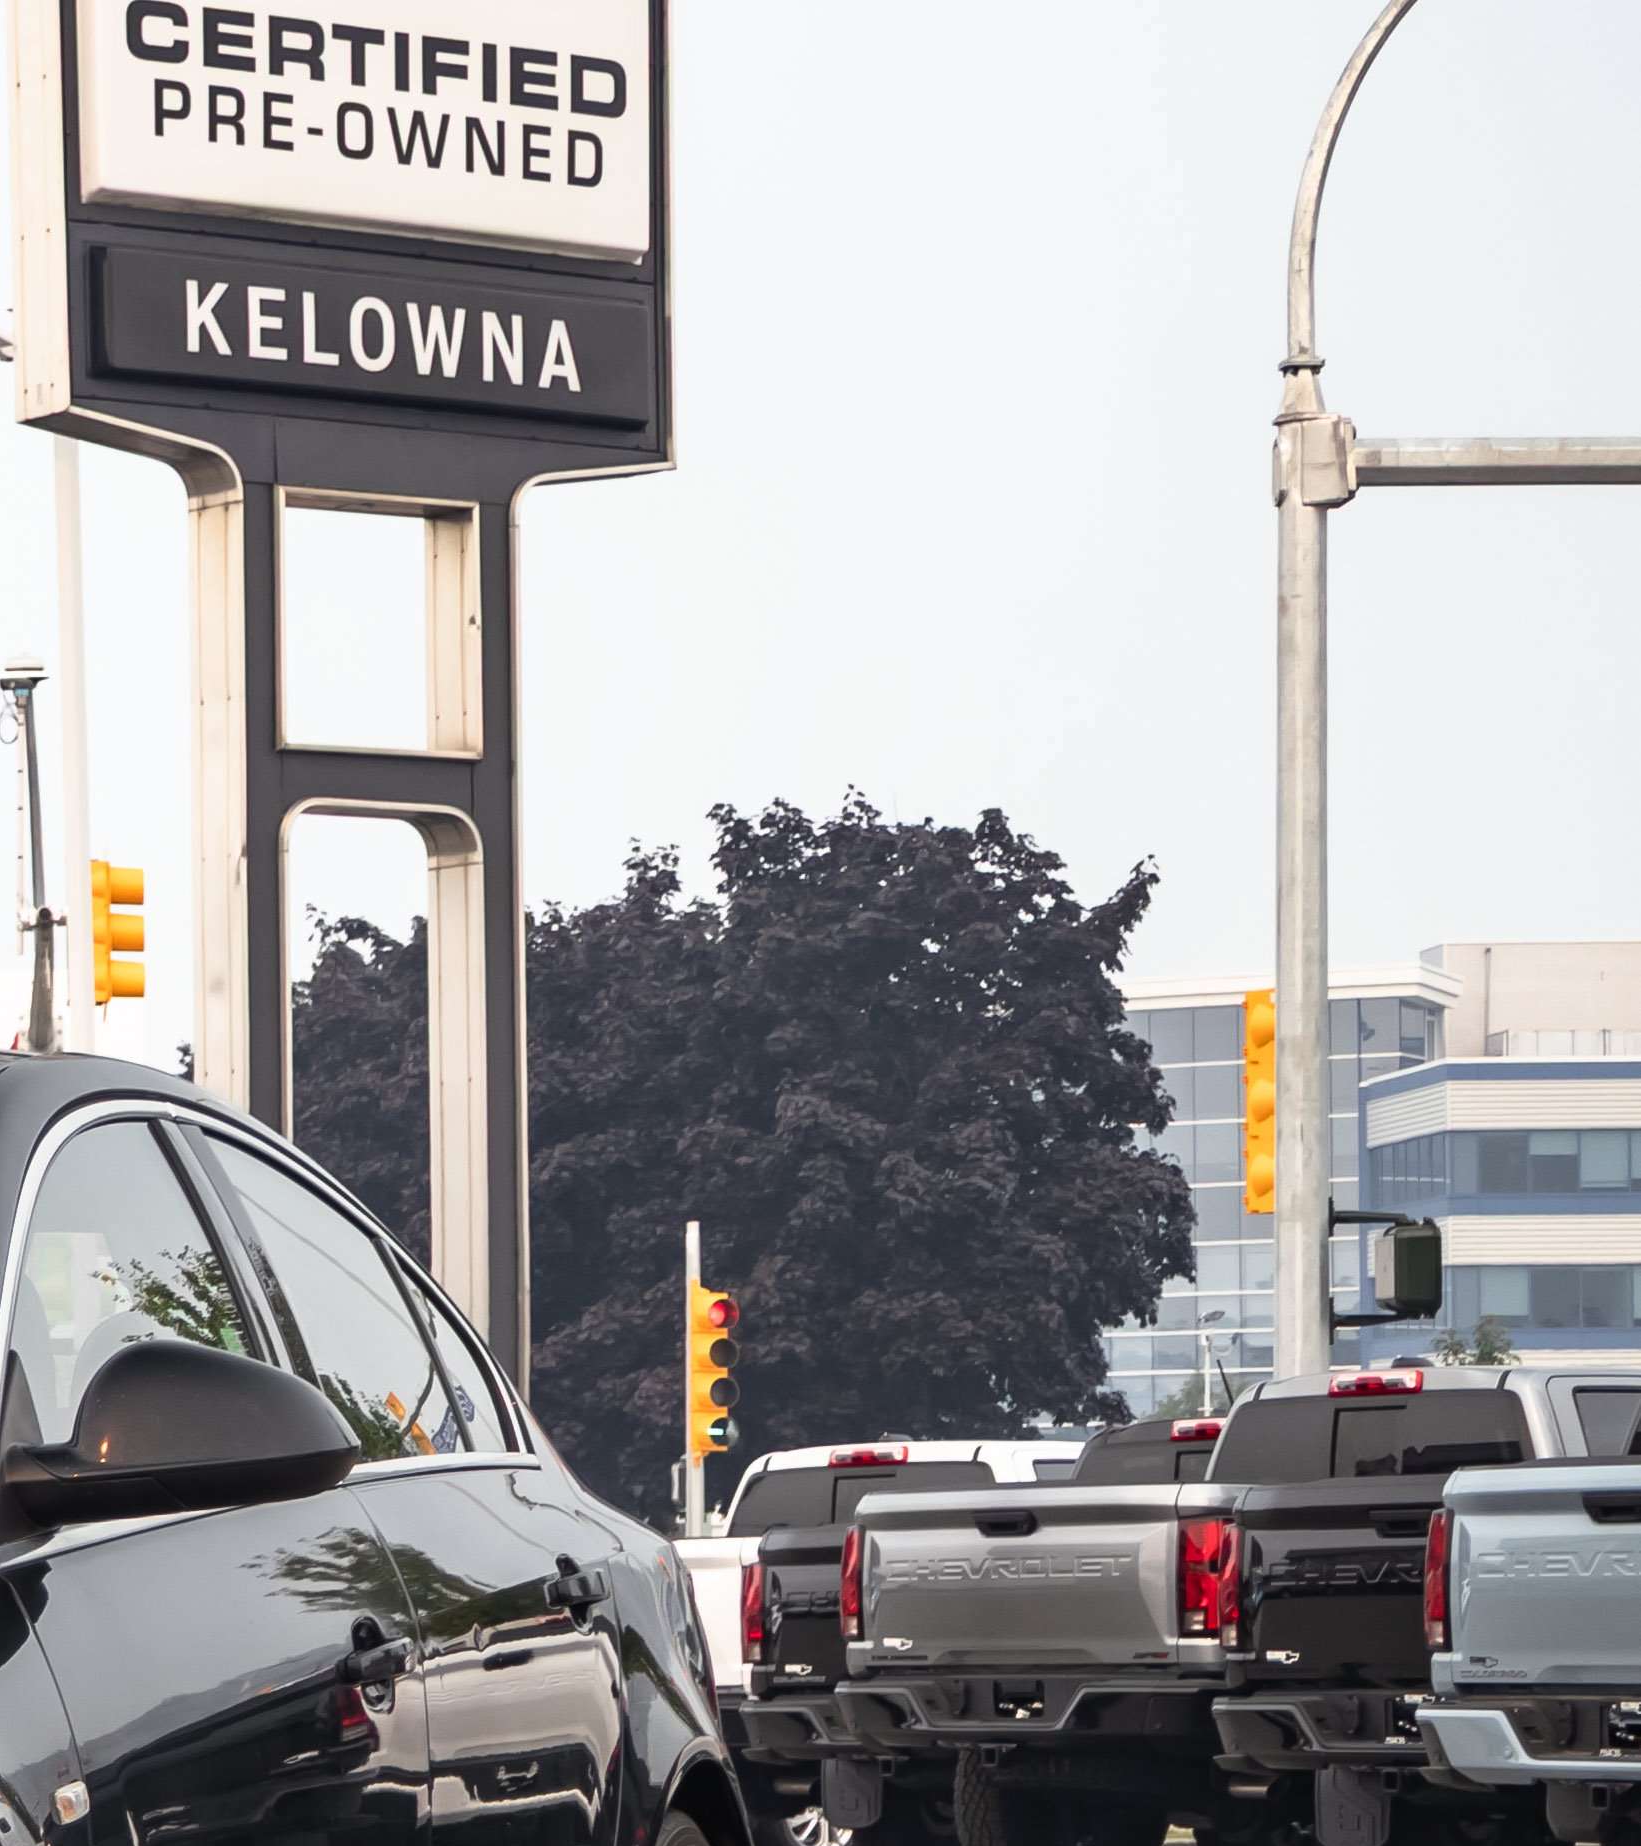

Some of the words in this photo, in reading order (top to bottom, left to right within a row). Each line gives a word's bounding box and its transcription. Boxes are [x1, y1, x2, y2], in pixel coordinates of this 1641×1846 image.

[124, 0, 627, 119] CERTIFIED
[154, 78, 604, 188] PRE-OWNED
[184, 278, 582, 393] KELOWNA
[886, 1555, 1133, 1582] CHEVROLET
